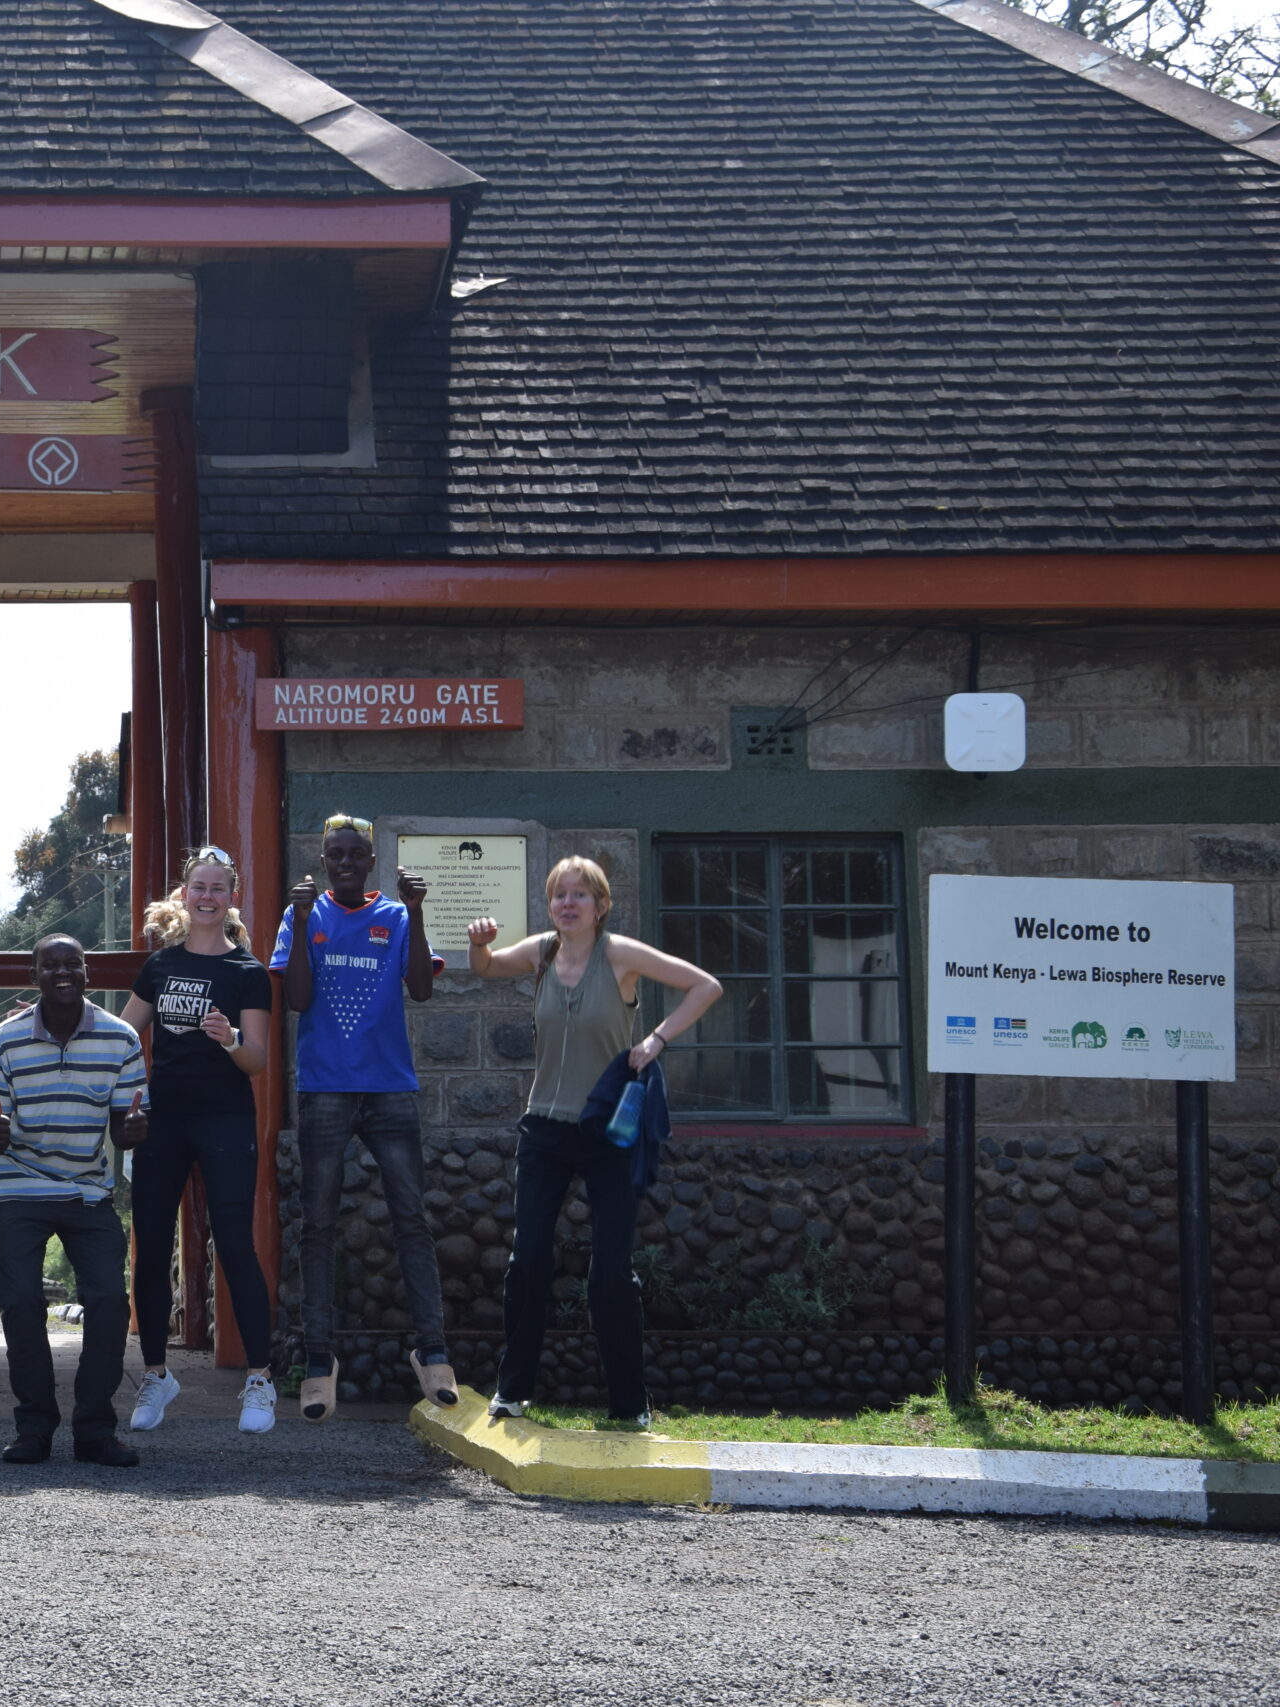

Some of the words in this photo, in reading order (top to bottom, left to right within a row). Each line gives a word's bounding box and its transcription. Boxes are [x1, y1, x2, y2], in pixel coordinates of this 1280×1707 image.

[274, 684, 415, 705] NAROMORU
[436, 684, 499, 705] GATE
[274, 708, 368, 724] ALTITUDE
[380, 708, 446, 724] 2400M
[1014, 917, 1120, 942] Welcome
[1127, 921, 1151, 943] to
[325, 954, 347, 966] NARU
[349, 956, 378, 970] YOUTH
[945, 961, 988, 979] Mount
[993, 963, 1036, 984] Kenya
[1049, 965, 1087, 982] Lewa
[1092, 966, 1163, 987] Biosphere
[1168, 969, 1226, 987] Reserve
[158, 994, 212, 1019] CROSSFIT
